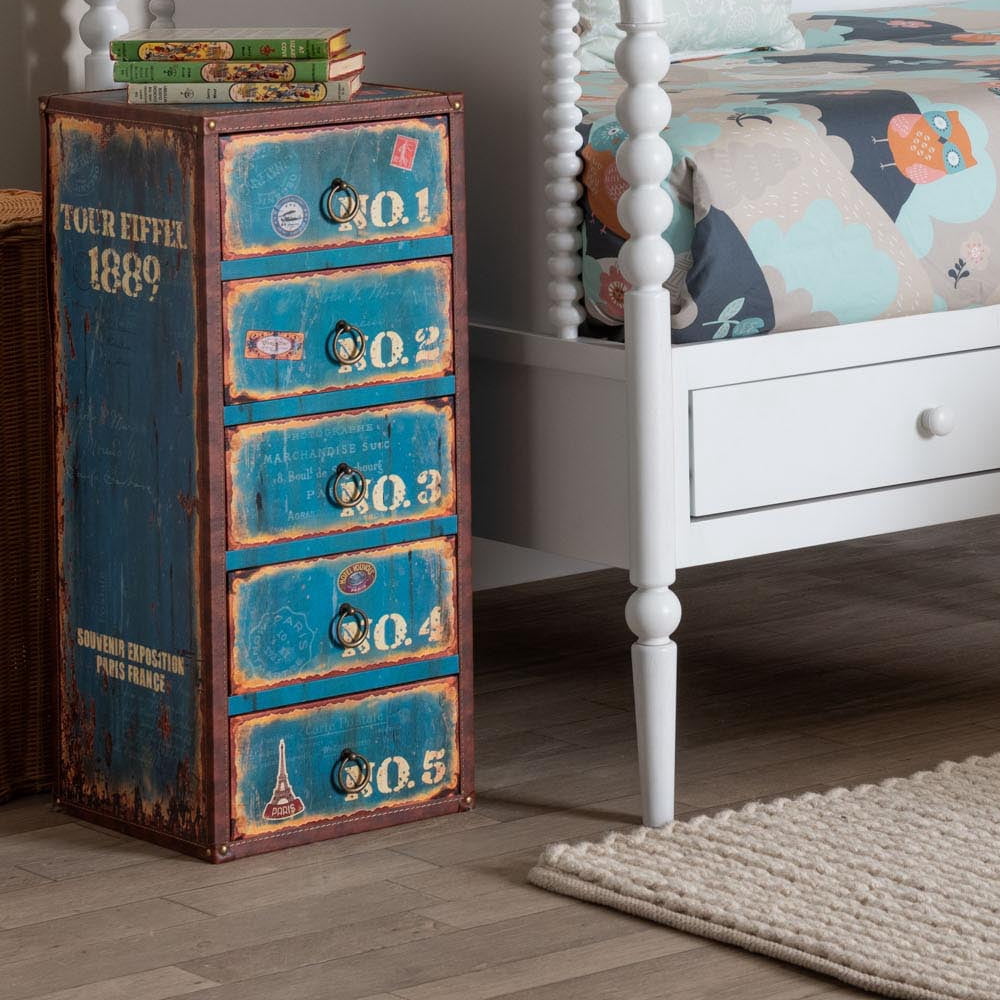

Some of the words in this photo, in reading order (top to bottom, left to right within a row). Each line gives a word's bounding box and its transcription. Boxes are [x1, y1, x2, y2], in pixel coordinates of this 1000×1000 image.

[60, 203, 116, 238] TOUR
[120, 211, 188, 249] EIFFEL
[88, 246, 161, 301] 1889
[262, 444, 357, 465] MARCHANDISE
[77, 627, 125, 659] SOUVENIR
[127, 641, 185, 676] EXPOSITION
[96, 655, 126, 681] PARIS
[127, 664, 165, 693] FRANCE
[271, 804, 296, 817] PARIS
